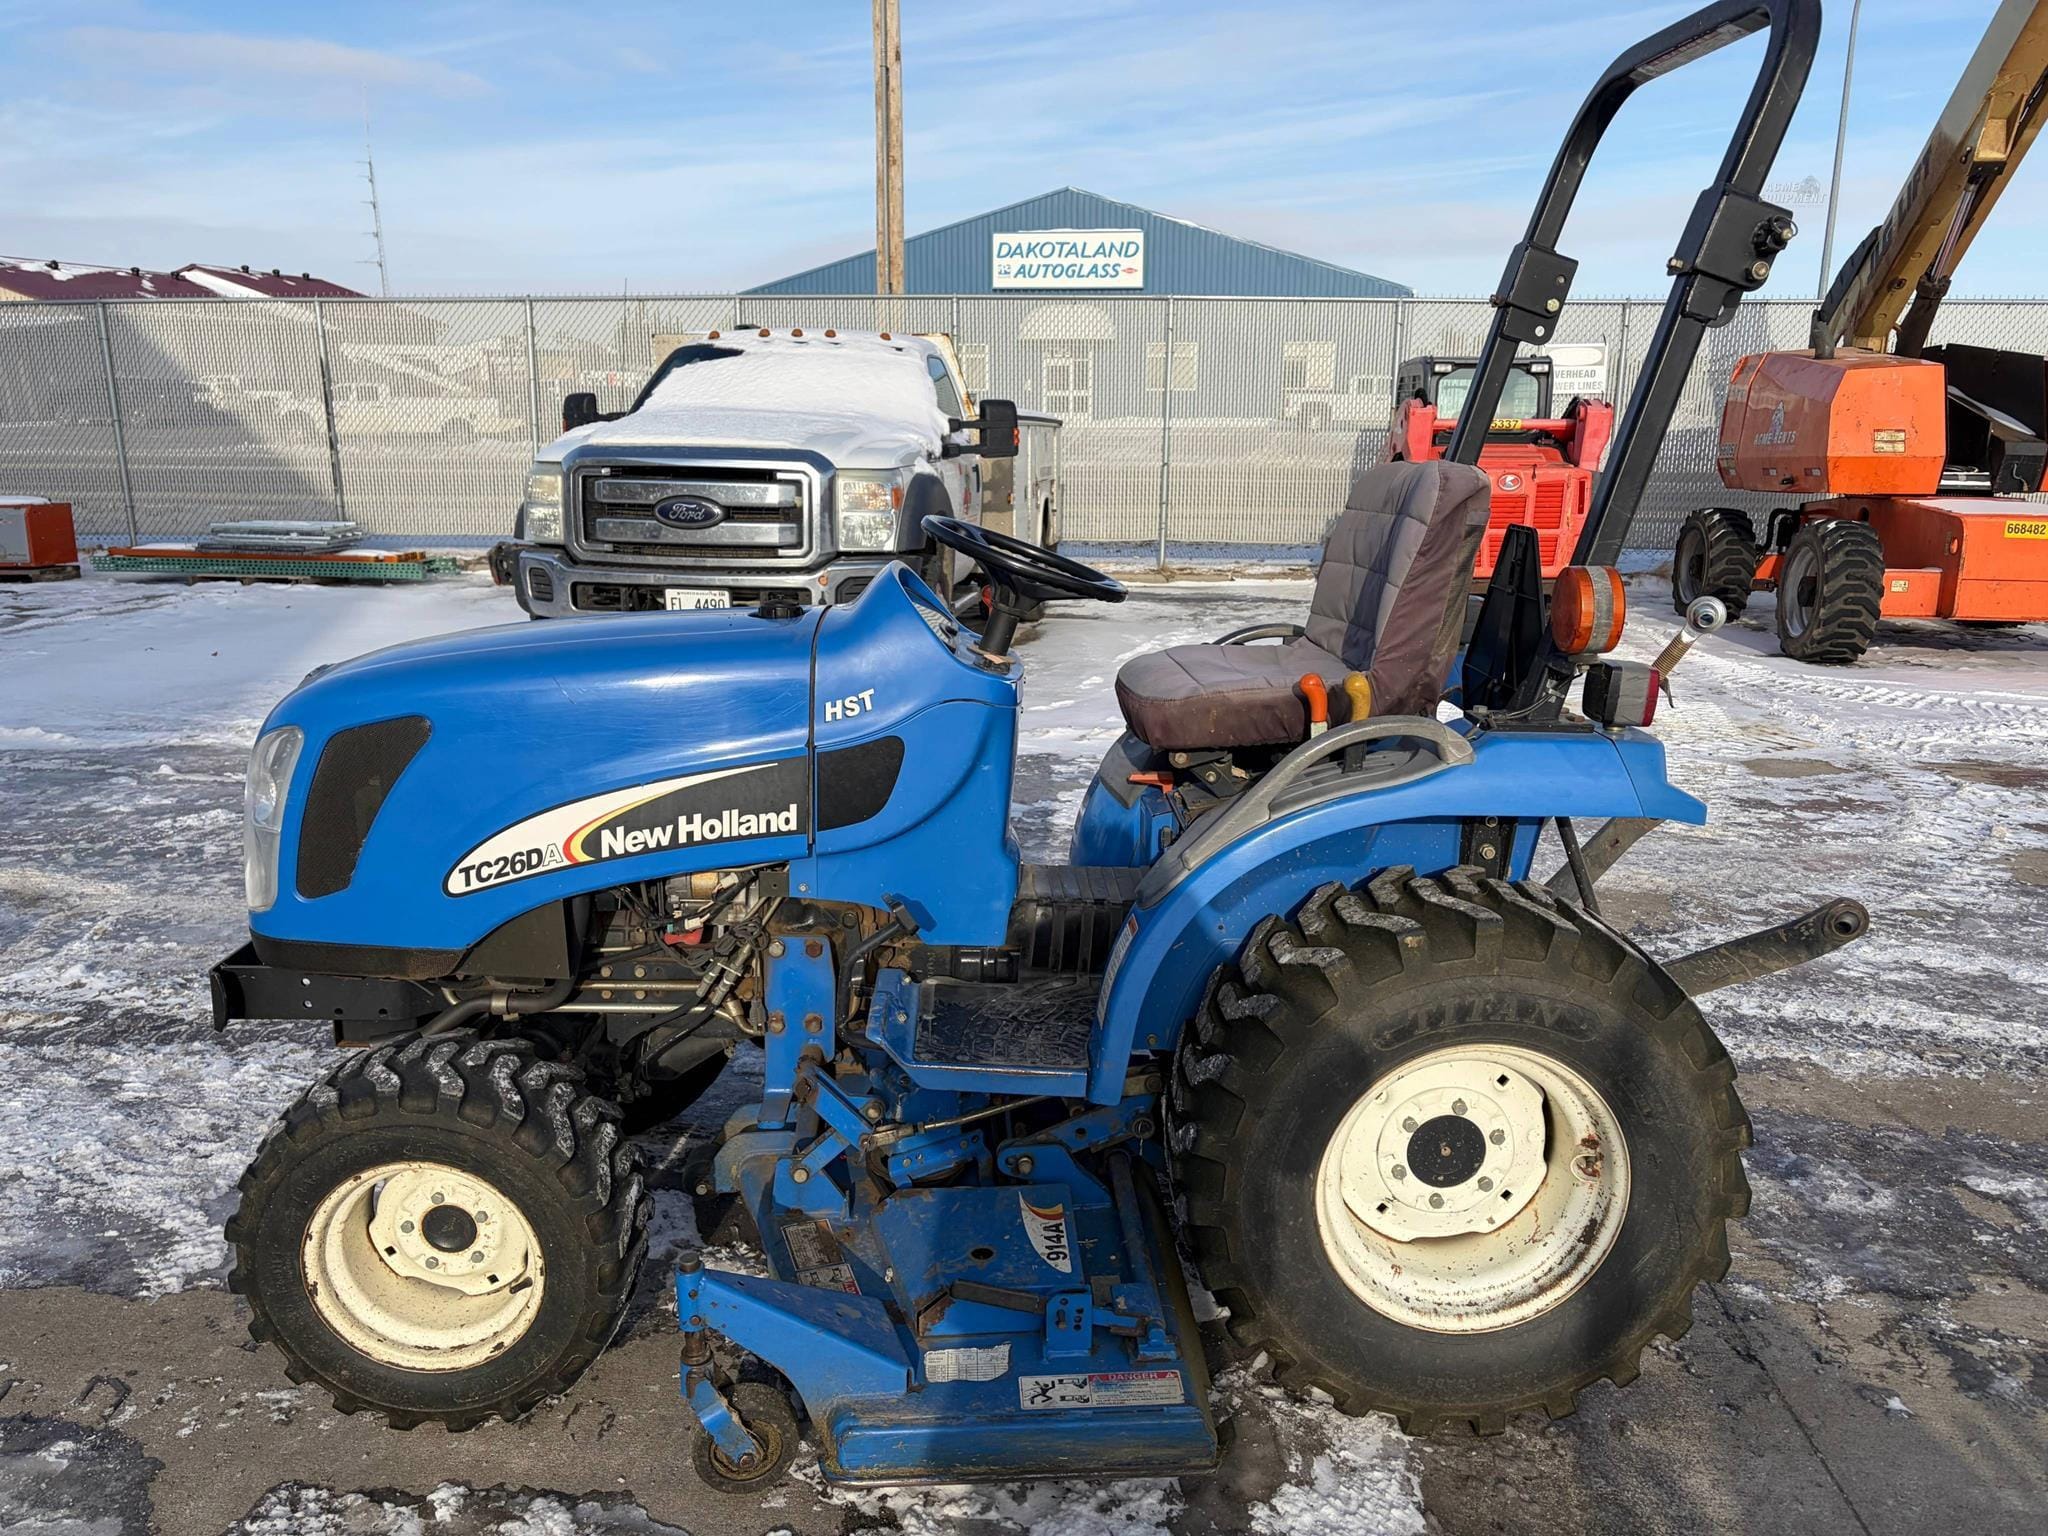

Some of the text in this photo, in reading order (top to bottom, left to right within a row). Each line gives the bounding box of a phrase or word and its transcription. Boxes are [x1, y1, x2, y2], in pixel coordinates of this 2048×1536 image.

[996, 241, 1140, 259] DAKOTALAND
[1013, 263, 1121, 279] AUTOGLASS
[1554, 369, 1596, 379] VERHEAD
[1555, 381, 1604, 391] WER LINES
[1752, 431, 1797, 445] ACME RENTS
[669, 502, 706, 520] Ford
[2007, 523, 2047, 535] 668482
[824, 688, 876, 723] HST
[600, 803, 798, 859] New Holland
[458, 843, 564, 888] TC26DA
[1042, 1222, 1068, 1261] 914A
[1108, 1372, 1158, 1382] DANGER
